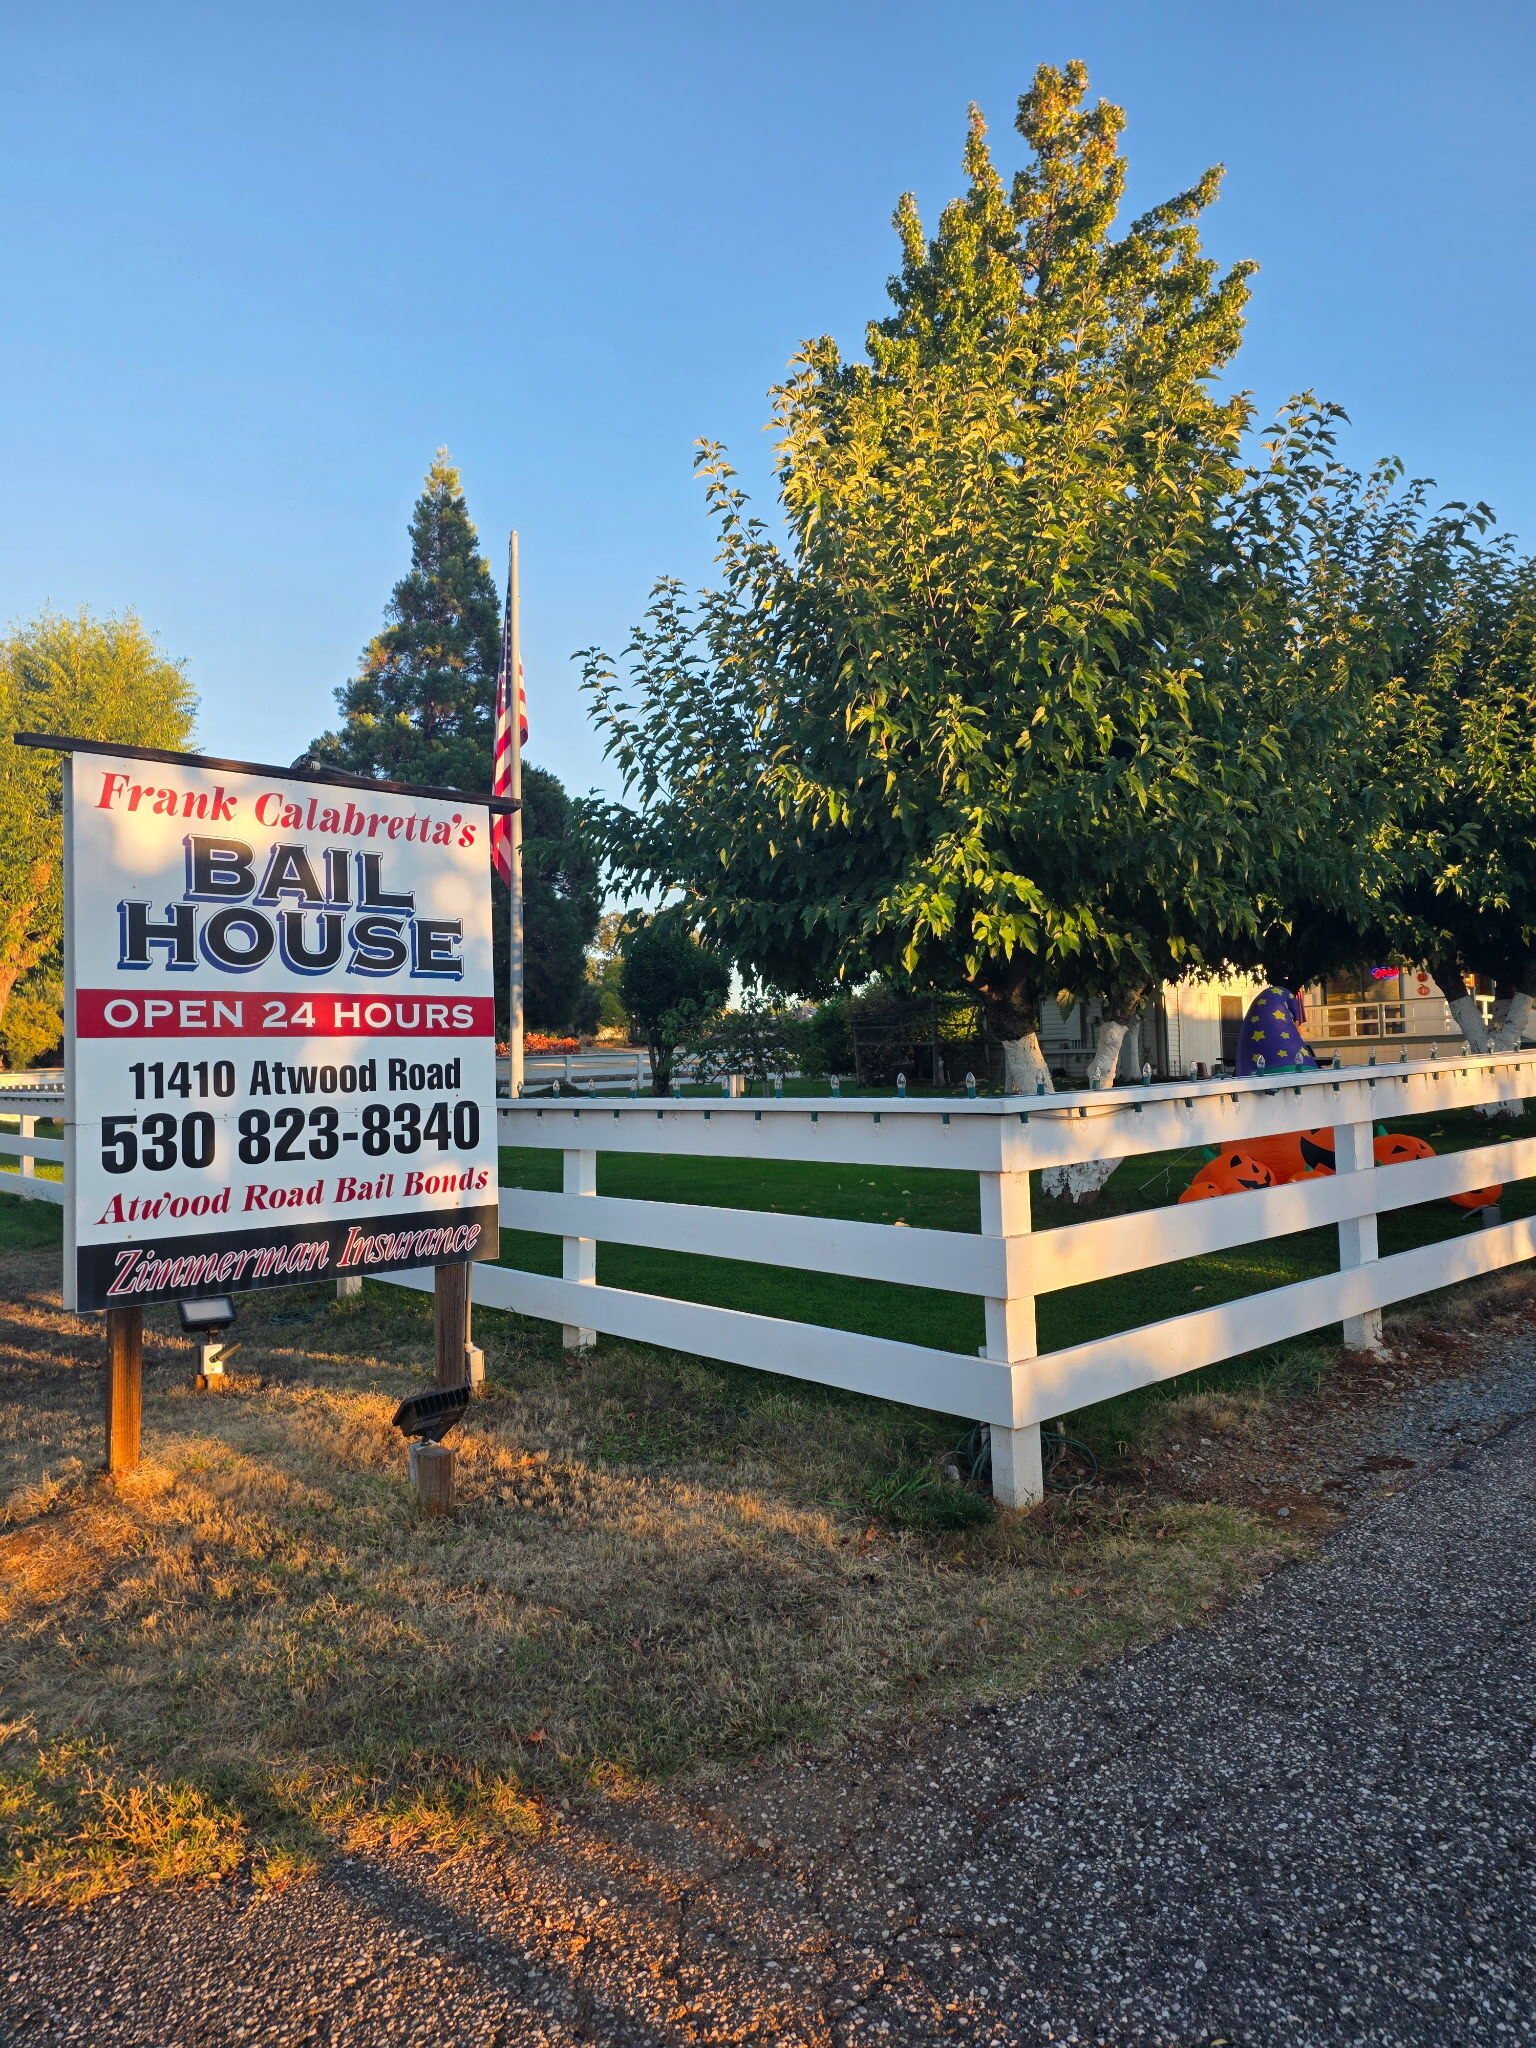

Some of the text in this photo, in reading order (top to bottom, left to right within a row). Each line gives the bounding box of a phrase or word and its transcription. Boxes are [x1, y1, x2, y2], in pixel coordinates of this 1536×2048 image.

[95, 772, 476, 848] Frank Calabretta's
[183, 834, 416, 917] BAIL
[117, 900, 464, 982] HOUSE
[104, 999, 474, 1029] OPEN 24 HOURS
[129, 1057, 461, 1099] 11410 Atwood Road
[101, 1100, 479, 1174] 530 823-8340
[94, 1167, 489, 1225] Atwood Road Bail Bonds
[107, 1224, 481, 1296] Zimmerman Insurance
